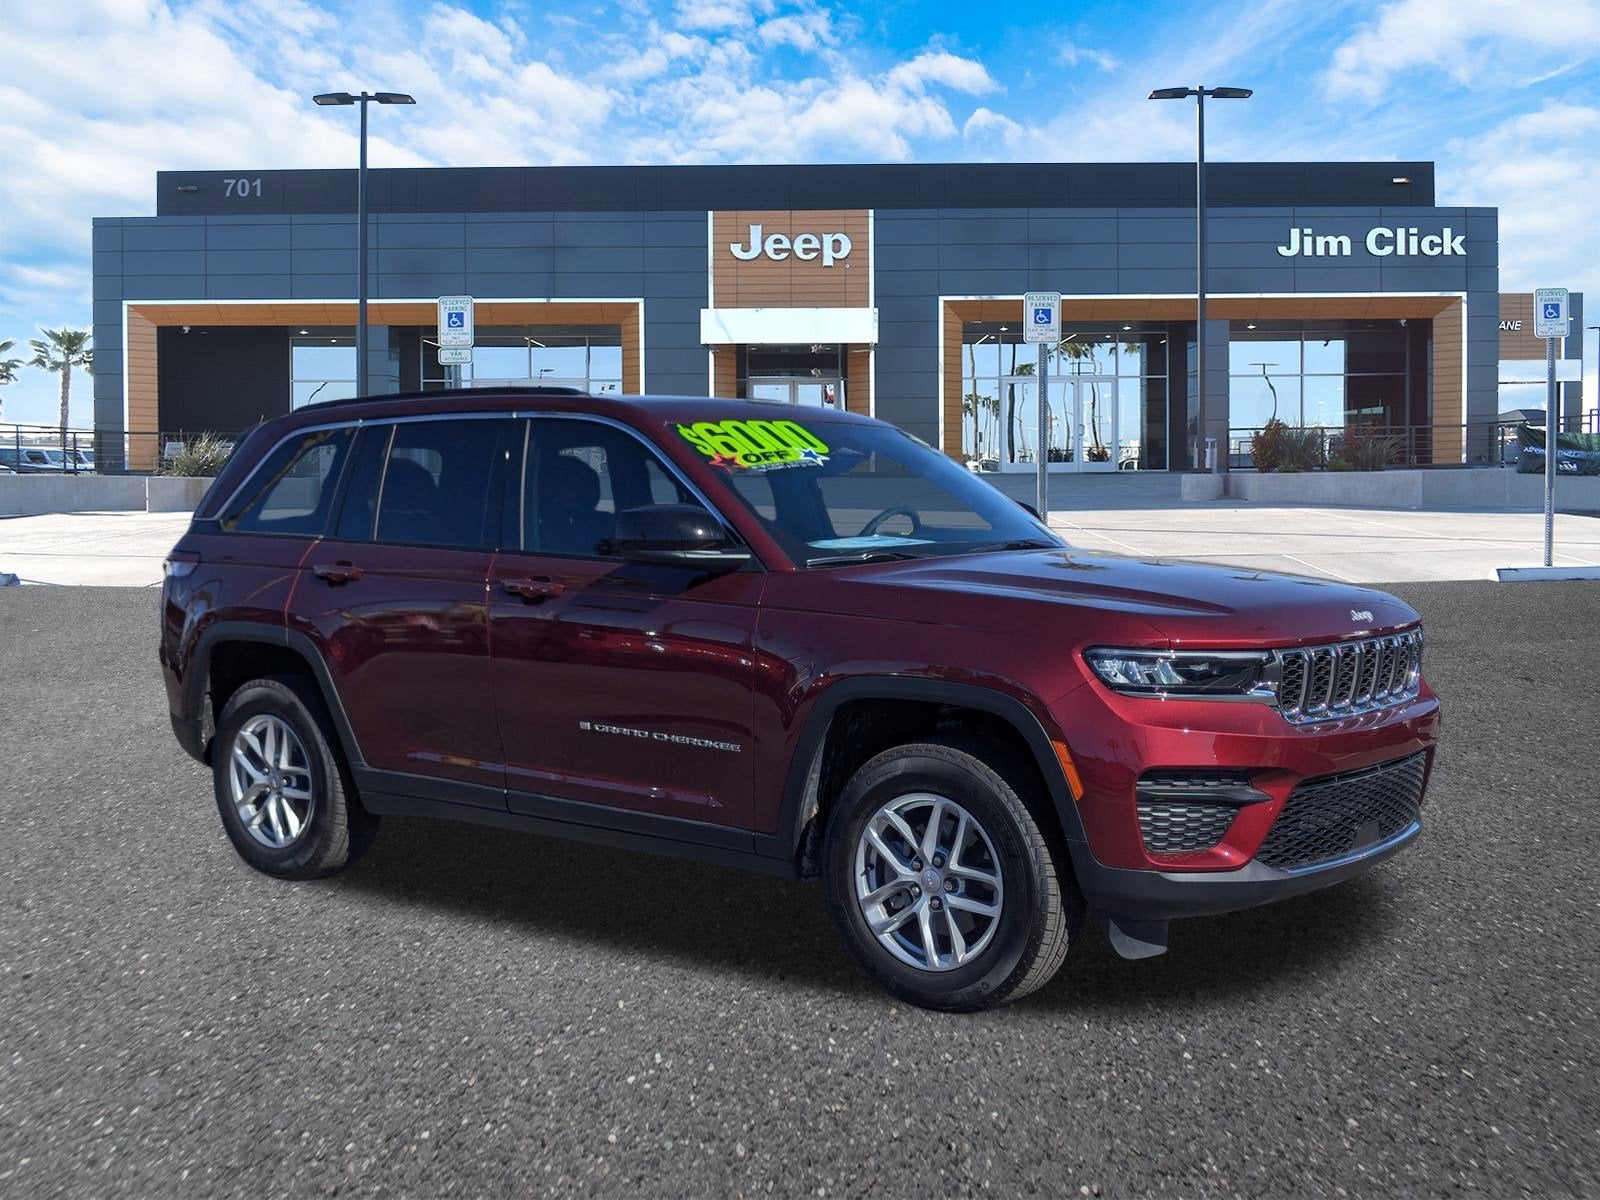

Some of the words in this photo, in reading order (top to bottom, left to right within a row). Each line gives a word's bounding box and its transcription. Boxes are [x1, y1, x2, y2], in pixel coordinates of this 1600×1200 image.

[223, 178, 262, 197] 701
[730, 224, 852, 267] Jeep
[1277, 228, 1352, 257] Jim
[1366, 227, 1467, 256] Click
[676, 420, 830, 456] $6000
[741, 450, 791, 464] OFF
[594, 723, 649, 738] GRAND
[652, 732, 742, 752] CHEROKEE
